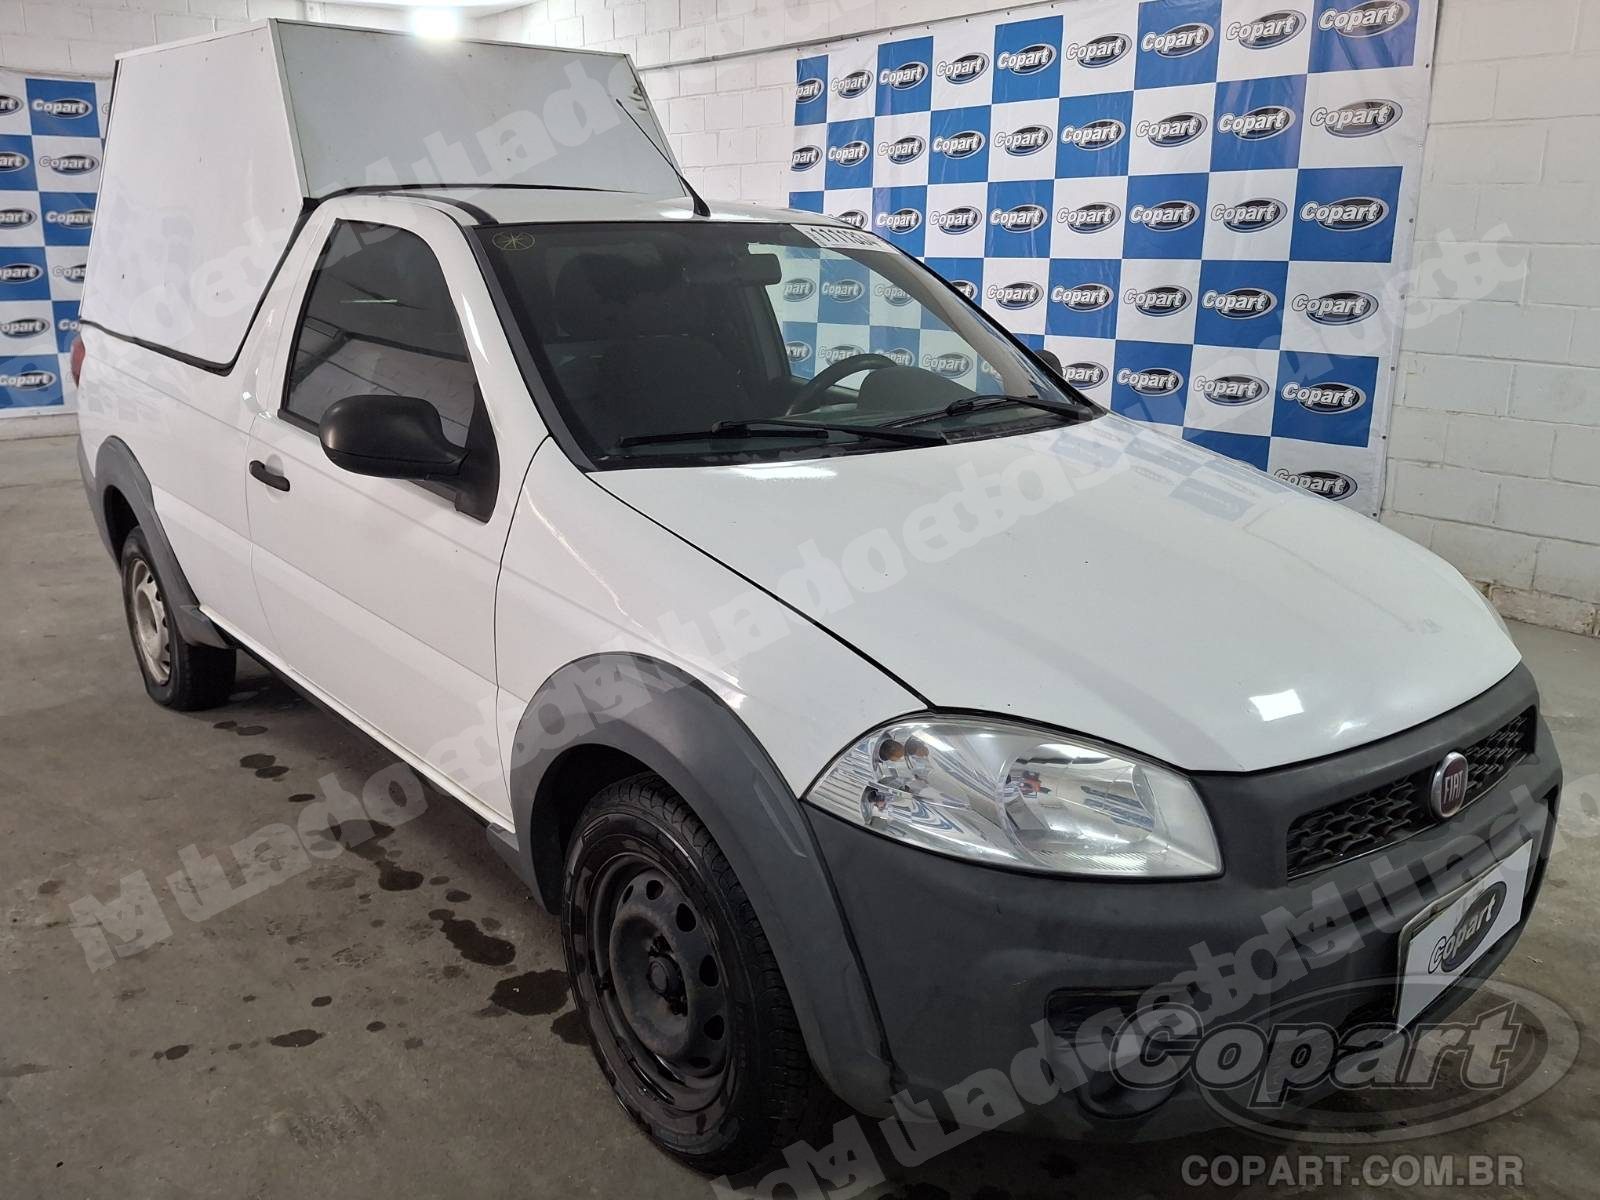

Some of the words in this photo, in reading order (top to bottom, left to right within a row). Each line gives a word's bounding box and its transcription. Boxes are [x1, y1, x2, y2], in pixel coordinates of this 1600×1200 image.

[1318, 2, 1400, 31] Copart
[1141, 26, 1208, 53] Copart
[1226, 14, 1298, 44] Copart
[997, 47, 1050, 72] Copart
[1066, 38, 1124, 63] Copart
[879, 65, 922, 86] Copart
[936, 57, 983, 81] Copart
[831, 75, 868, 95] Copart
[32, 98, 86, 115] Copart
[1310, 102, 1393, 130] Copart
[1061, 121, 1122, 146] Copart
[1136, 117, 1201, 141] Copart
[1217, 109, 1288, 136] Copart
[828, 144, 867, 161] Copart
[878, 139, 922, 160] Copart
[933, 132, 982, 157] Copart
[994, 127, 1047, 154] Copart
[0, 157, 22, 168] art
[39, 155, 92, 171] Copart
[792, 151, 816, 166] part
[45, 210, 94, 226] Copar
[876, 212, 916, 230] Copart
[929, 207, 979, 231] Copart
[990, 205, 1042, 230] Copart
[1056, 206, 1113, 227] Copart
[1129, 204, 1193, 228] Copart
[1211, 203, 1277, 229] Copart
[1300, 202, 1382, 229] Copart
[784, 281, 810, 296] part
[821, 281, 859, 298] Copart
[987, 284, 1035, 304] Copart
[1050, 285, 1107, 306] Copart
[1123, 288, 1184, 312] Copart
[1201, 289, 1268, 312] Copart
[1291, 293, 1368, 318] Copart
[0, 320, 42, 335] opart
[922, 354, 966, 372] Copart
[1117, 368, 1179, 391] Copart
[1193, 374, 1259, 397] Copart
[1281, 382, 1359, 407] Copart
[1444, 770, 1463, 803] FIAT
[1428, 893, 1497, 974] Copart
